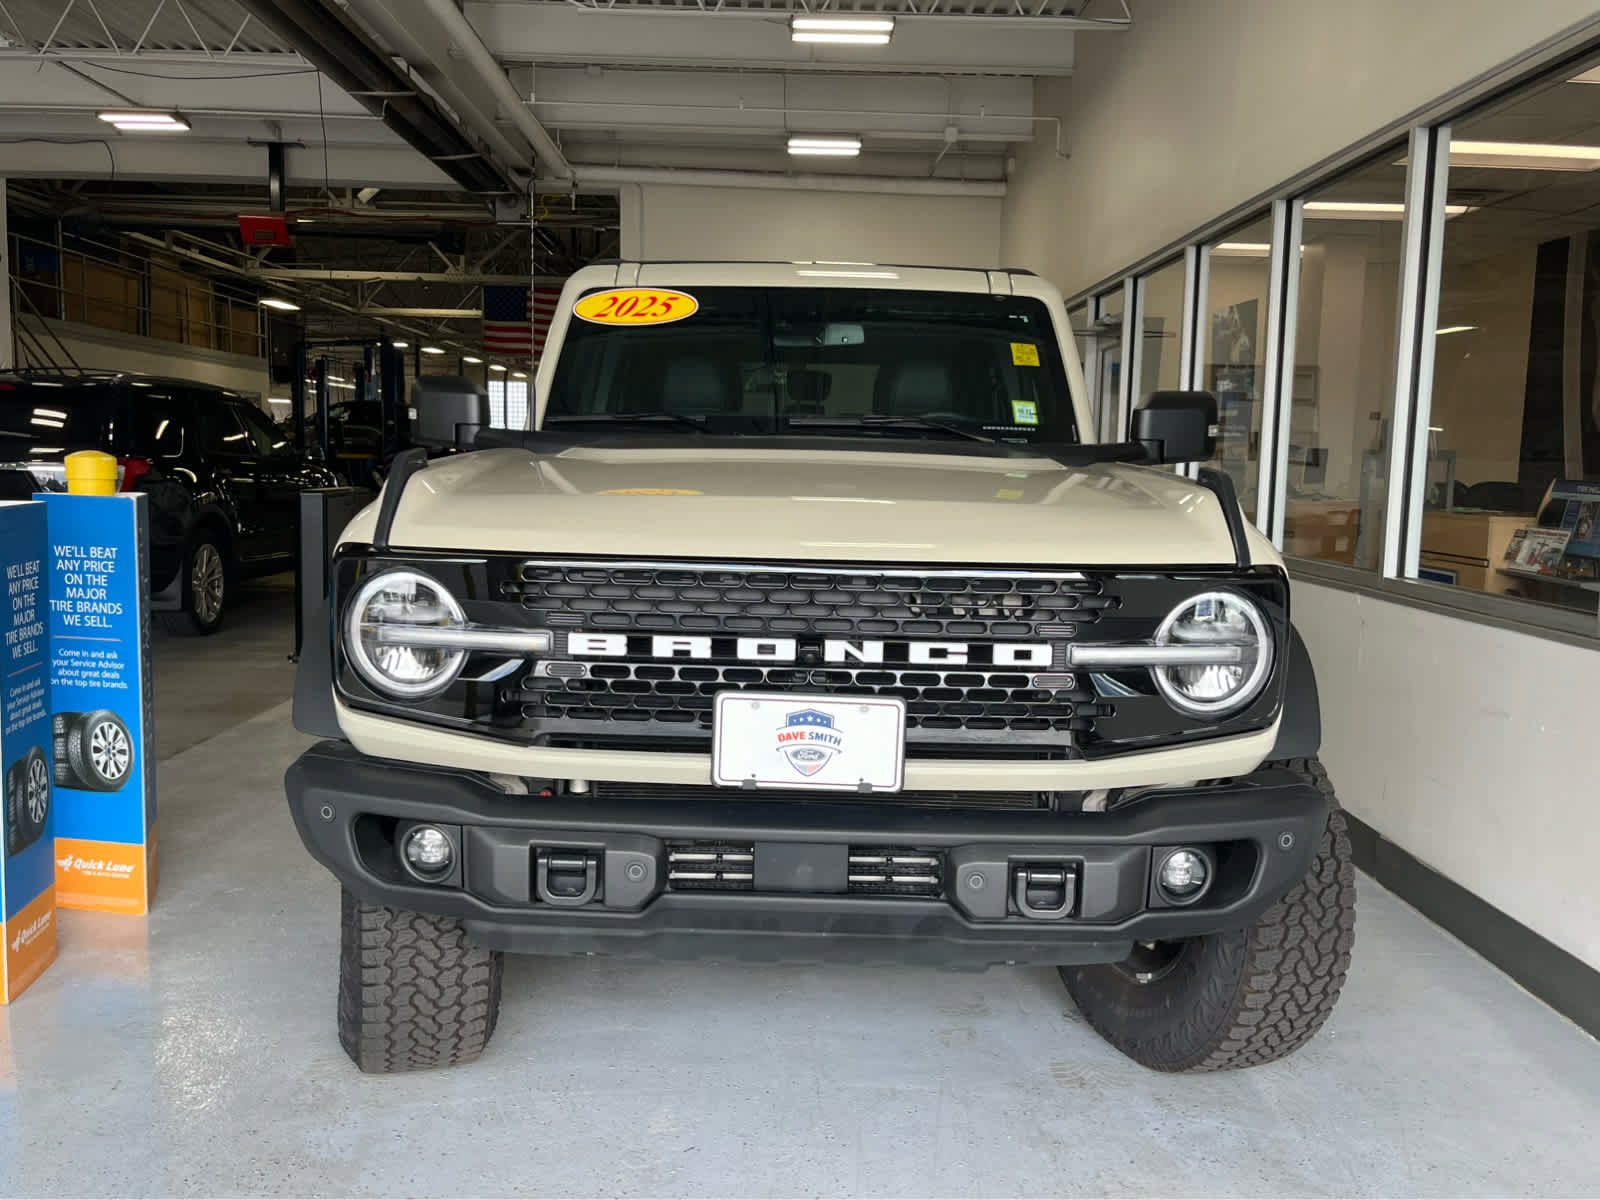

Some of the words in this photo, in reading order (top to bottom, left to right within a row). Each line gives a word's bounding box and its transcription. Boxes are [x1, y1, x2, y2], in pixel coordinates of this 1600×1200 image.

[592, 296, 680, 318] 2025
[54, 545, 87, 558] WE'LL
[90, 546, 118, 559] BEAT
[6, 564, 24, 579] WE'LL
[25, 560, 40, 575] BEAT
[56, 560, 80, 572] ANY
[83, 560, 115, 573] PRICE
[8, 582, 21, 597] ANY
[22, 576, 39, 592] PRICE
[64, 573, 82, 585] ON
[85, 574, 108, 586] THE
[66, 587, 107, 600] MAJOR
[12, 597, 23, 611] ON
[23, 593, 36, 607] THE
[50, 600, 73, 613] TIRE
[77, 601, 123, 615] BRANDS
[13, 609, 35, 626] MAJOR
[63, 615, 82, 626] WE
[84, 616, 112, 628] SELL.
[5, 630, 18, 647] TIRE
[19, 622, 44, 640] BRANDS
[12, 645, 22, 660] WE
[58, 648, 80, 657] Come
[82, 649, 88, 657] in
[90, 650, 104, 658] and
[106, 651, 118, 659] ask
[567, 631, 1053, 667] BRONCO
[52, 659, 69, 667] your
[70, 659, 96, 668] Service
[98, 661, 125, 670] Advisor
[58, 668, 80, 677] about
[81, 670, 100, 679] great
[101, 670, 120, 679] deals
[61, 678, 73, 686] the
[74, 679, 88, 688] top
[777, 731, 806, 743] DAVE
[808, 731, 842, 746] SMITH
[73, 858, 104, 870] Quick
[106, 861, 135, 873] Lane
